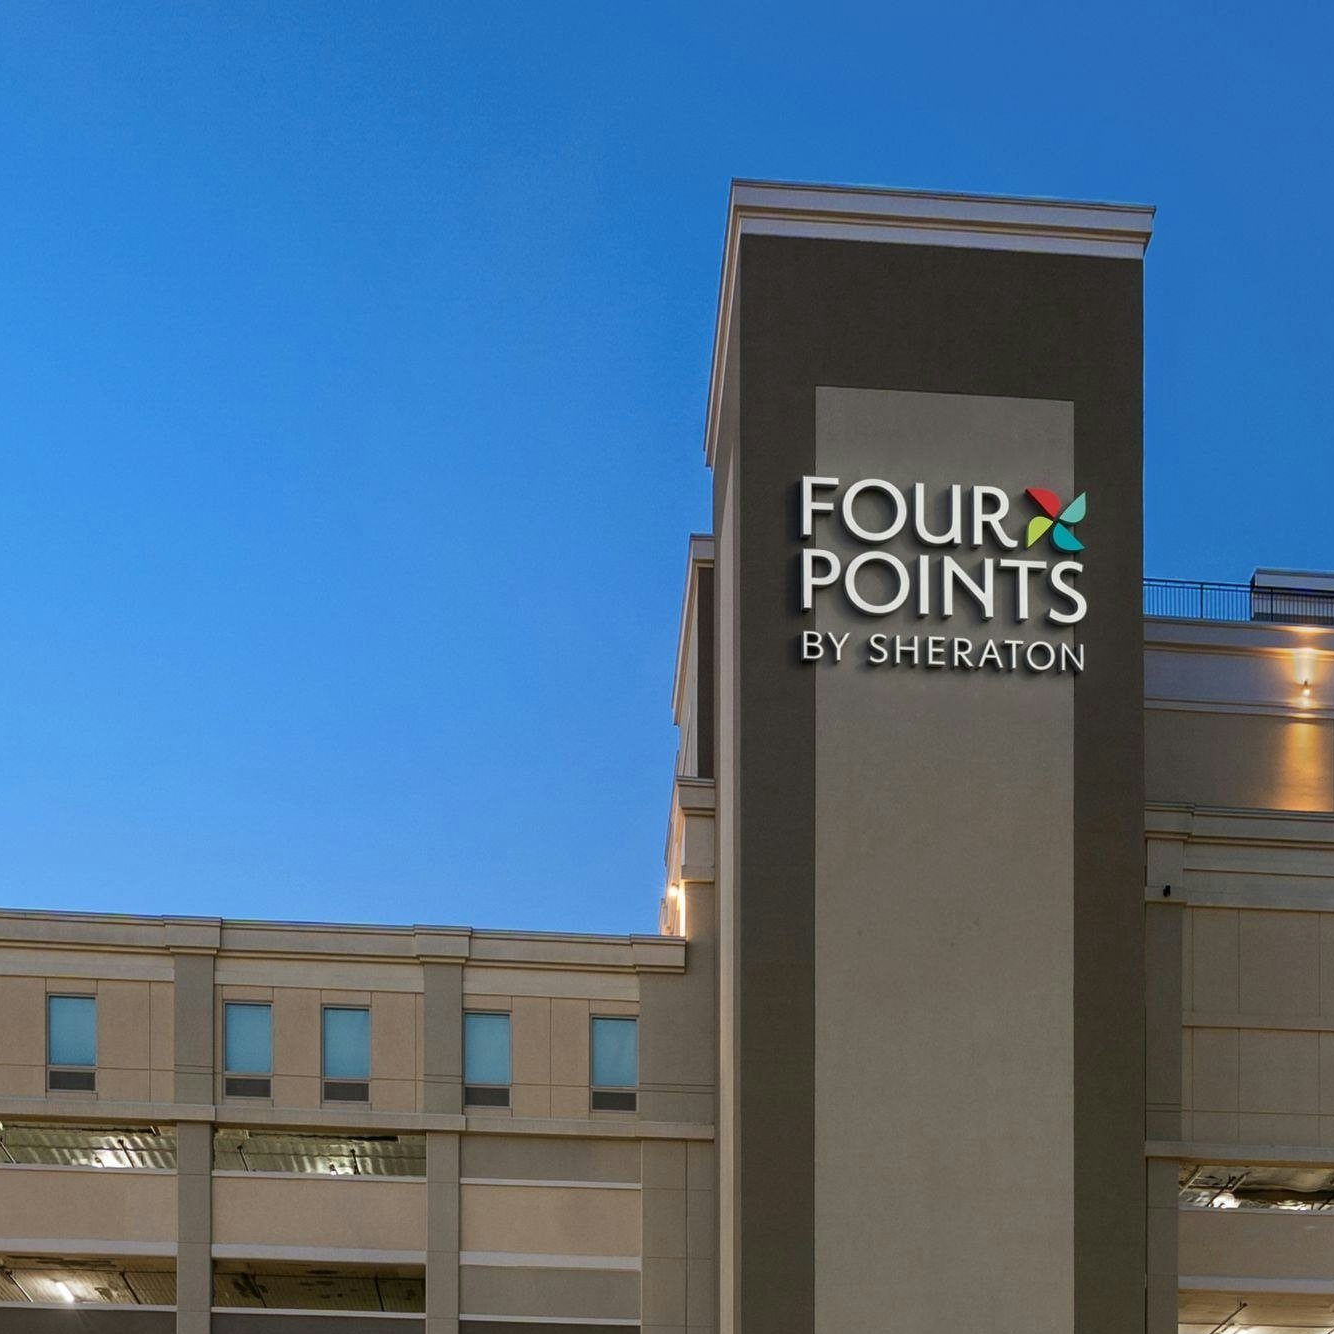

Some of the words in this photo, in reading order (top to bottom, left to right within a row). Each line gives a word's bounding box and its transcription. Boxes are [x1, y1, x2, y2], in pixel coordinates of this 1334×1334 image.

[800, 476, 1019, 548] FOUR
[801, 548, 1088, 625] POINTS
[802, 630, 851, 662] BY
[869, 633, 1085, 672] SHERATON
